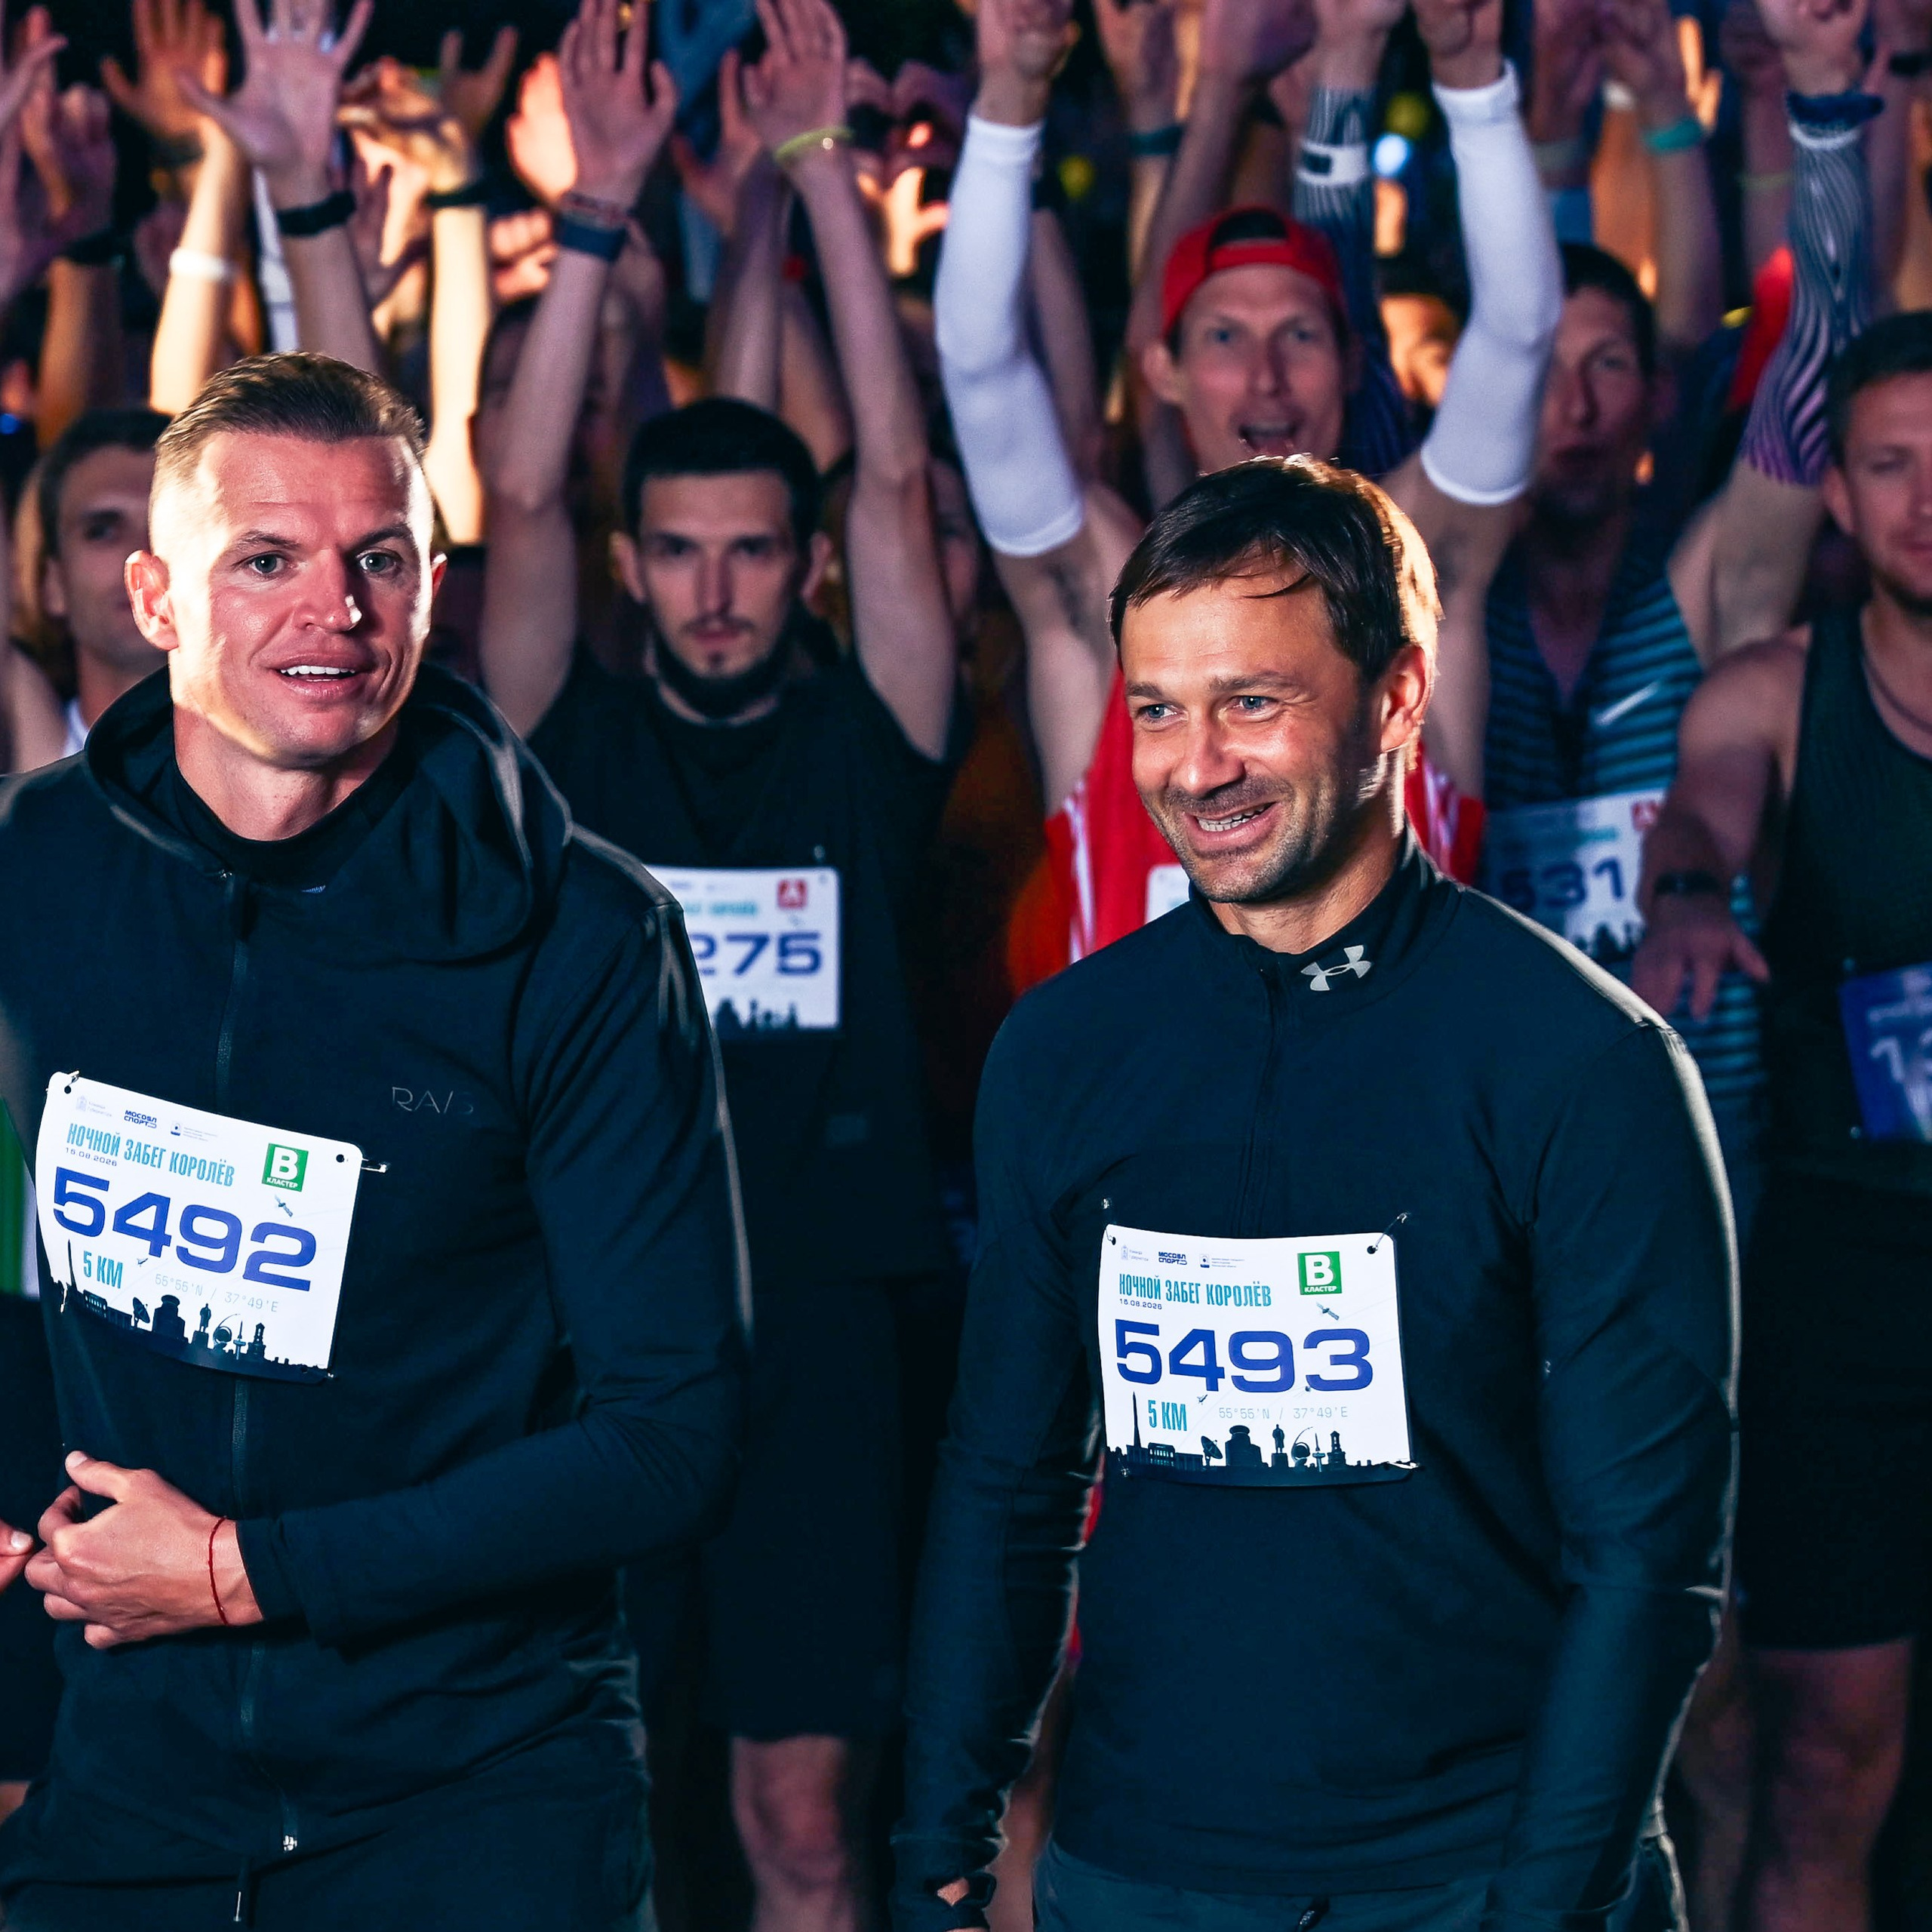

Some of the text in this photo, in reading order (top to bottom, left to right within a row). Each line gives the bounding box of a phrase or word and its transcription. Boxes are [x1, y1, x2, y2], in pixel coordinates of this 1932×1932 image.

[66, 1123, 235, 1187] НОЧНОЙ ЗАБЕГ КОРОЛЁВ
[270, 1146, 298, 1180] В
[266, 1177, 298, 1189] КЛАСТЕР
[54, 1166, 316, 1291] 5492
[83, 1250, 93, 1278] 5
[1305, 1254, 1334, 1286] В
[1119, 1273, 1272, 1307] НОЧНОЙ ЗАБЕГ КОРОЛЁВ
[1115, 1318, 1374, 1393] 5493
[1148, 1399, 1157, 1429] 5
